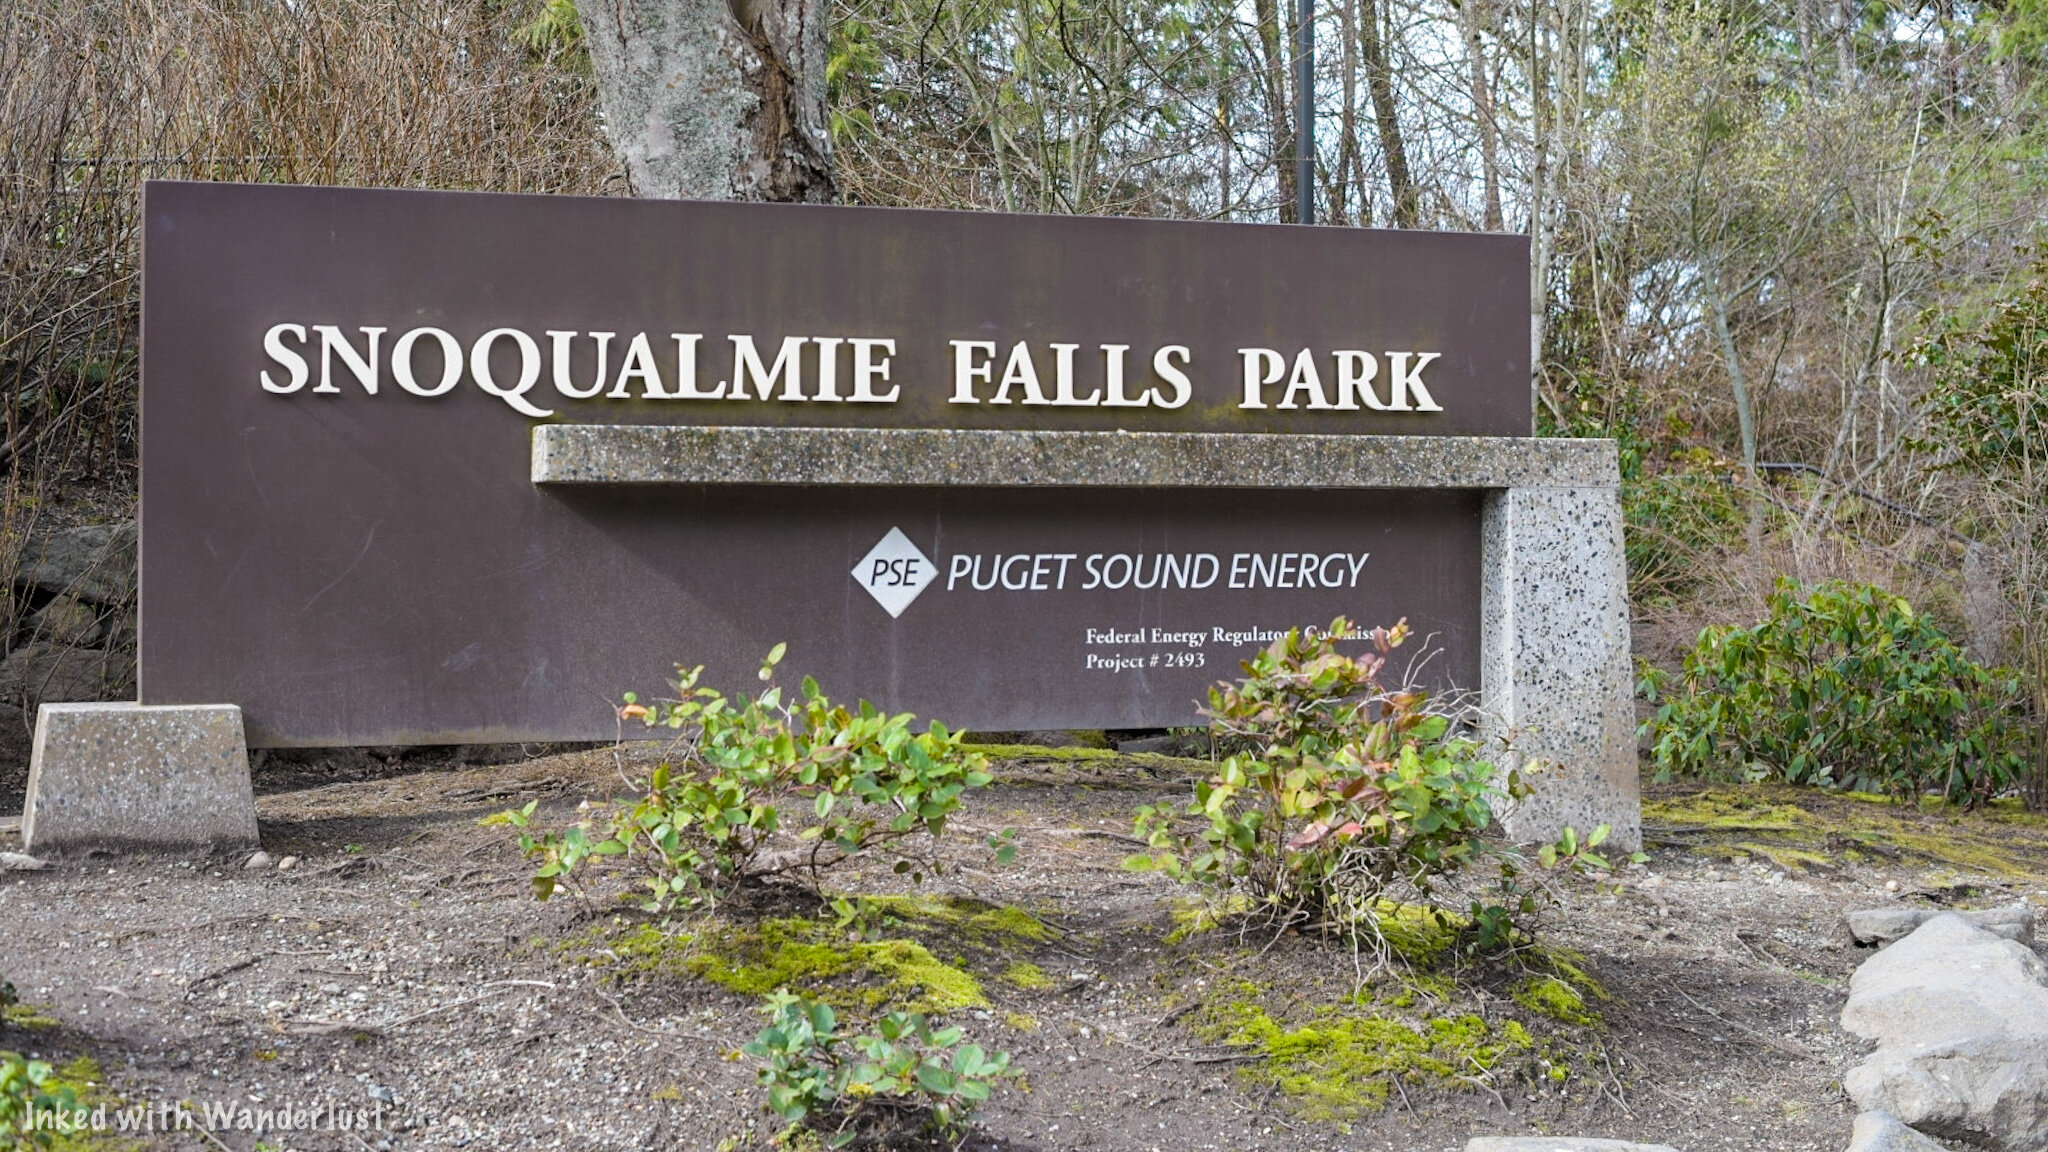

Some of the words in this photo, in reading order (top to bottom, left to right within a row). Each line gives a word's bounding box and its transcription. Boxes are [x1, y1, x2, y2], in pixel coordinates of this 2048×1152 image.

[260, 322, 901, 418] SNOQUALMIE
[948, 339, 1192, 409] FALLS
[1237, 347, 1444, 412] PARK
[870, 558, 920, 587] PSE
[947, 553, 1077, 591] PUGET
[1081, 552, 1220, 590] SOUND
[1228, 552, 1370, 589] ENERGY
[1085, 627, 1146, 644] Federal
[1150, 627, 1207, 649] Energy
[1212, 626, 1300, 648] Regulator
[1085, 653, 1145, 674] Project
[1149, 653, 1160, 669] #
[1164, 652, 1206, 669] 2493
